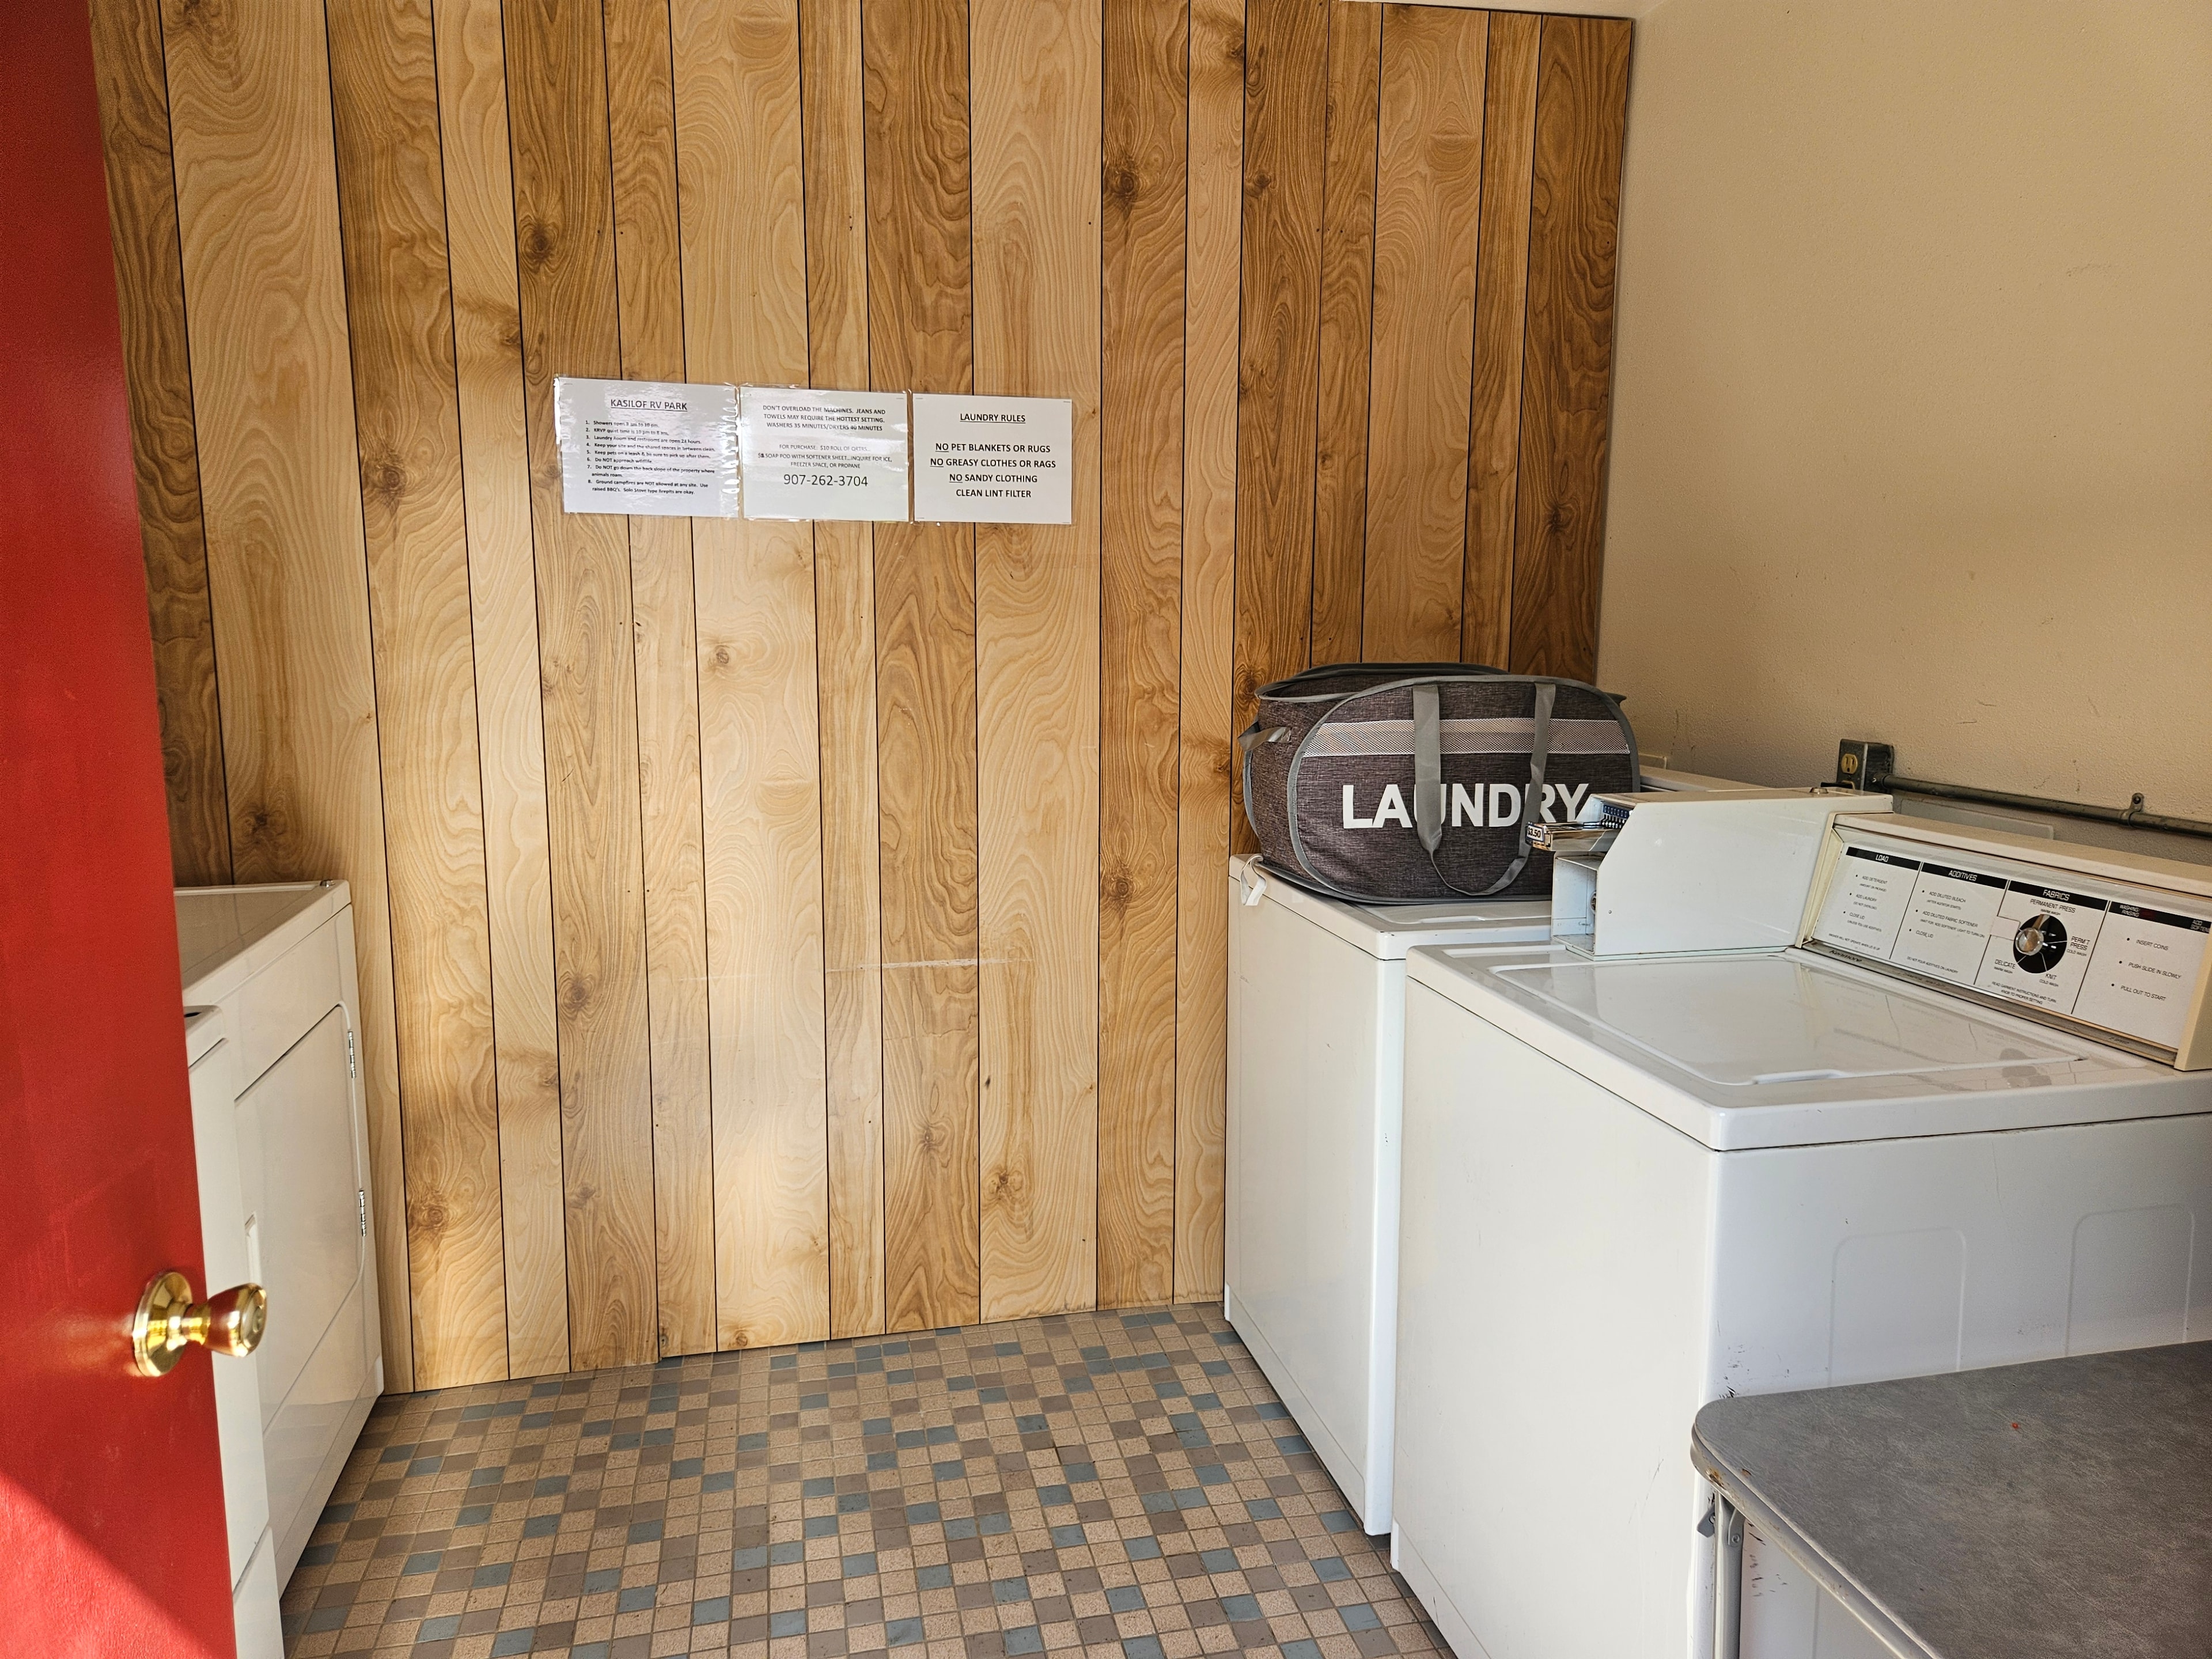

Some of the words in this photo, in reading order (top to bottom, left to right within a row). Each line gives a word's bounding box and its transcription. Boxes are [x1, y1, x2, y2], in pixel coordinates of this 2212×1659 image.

[611, 399, 647, 408] KASILOF
[650, 401, 661, 409] RV
[664, 402, 687, 410] PARK
[960, 413, 999, 422] LAUNDRY
[1001, 414, 1026, 422] RULES
[951, 443, 966, 451] PET
[969, 444, 1011, 452] BLANKETS
[1013, 444, 1025, 452] OR
[1028, 445, 1051, 453] RUGS
[930, 458, 944, 466] NO
[946, 459, 978, 467] GREASY
[980, 459, 1017, 467] CLOTHES
[1033, 460, 1056, 468] RAGS
[783, 474, 868, 487] 907-262-3704
[964, 474, 993, 482] SANDY
[995, 474, 1037, 482] CLOTHING
[985, 489, 1003, 497] LINT
[1343, 783, 1589, 828] LANDRY
[1528, 827, 1541, 838] $3.50
[1876, 854, 1889, 862] LOAD
[1948, 870, 1978, 881] ADDITIVES
[2043, 889, 2070, 901] FABRICS
[2030, 899, 2058, 909] PERMANENT
[2059, 905, 2075, 913] PRESS
[1959, 919, 1978, 927] SOFTENER
[2070, 942, 2088, 950] PRESS
[2136, 939, 2153, 947] INSERT
[2154, 943, 2169, 951] COINS
[1829, 950, 1862, 963] Kenmore
[1995, 959, 2016, 969] DELICATE
[2162, 971, 2181, 979] SLOWLY
